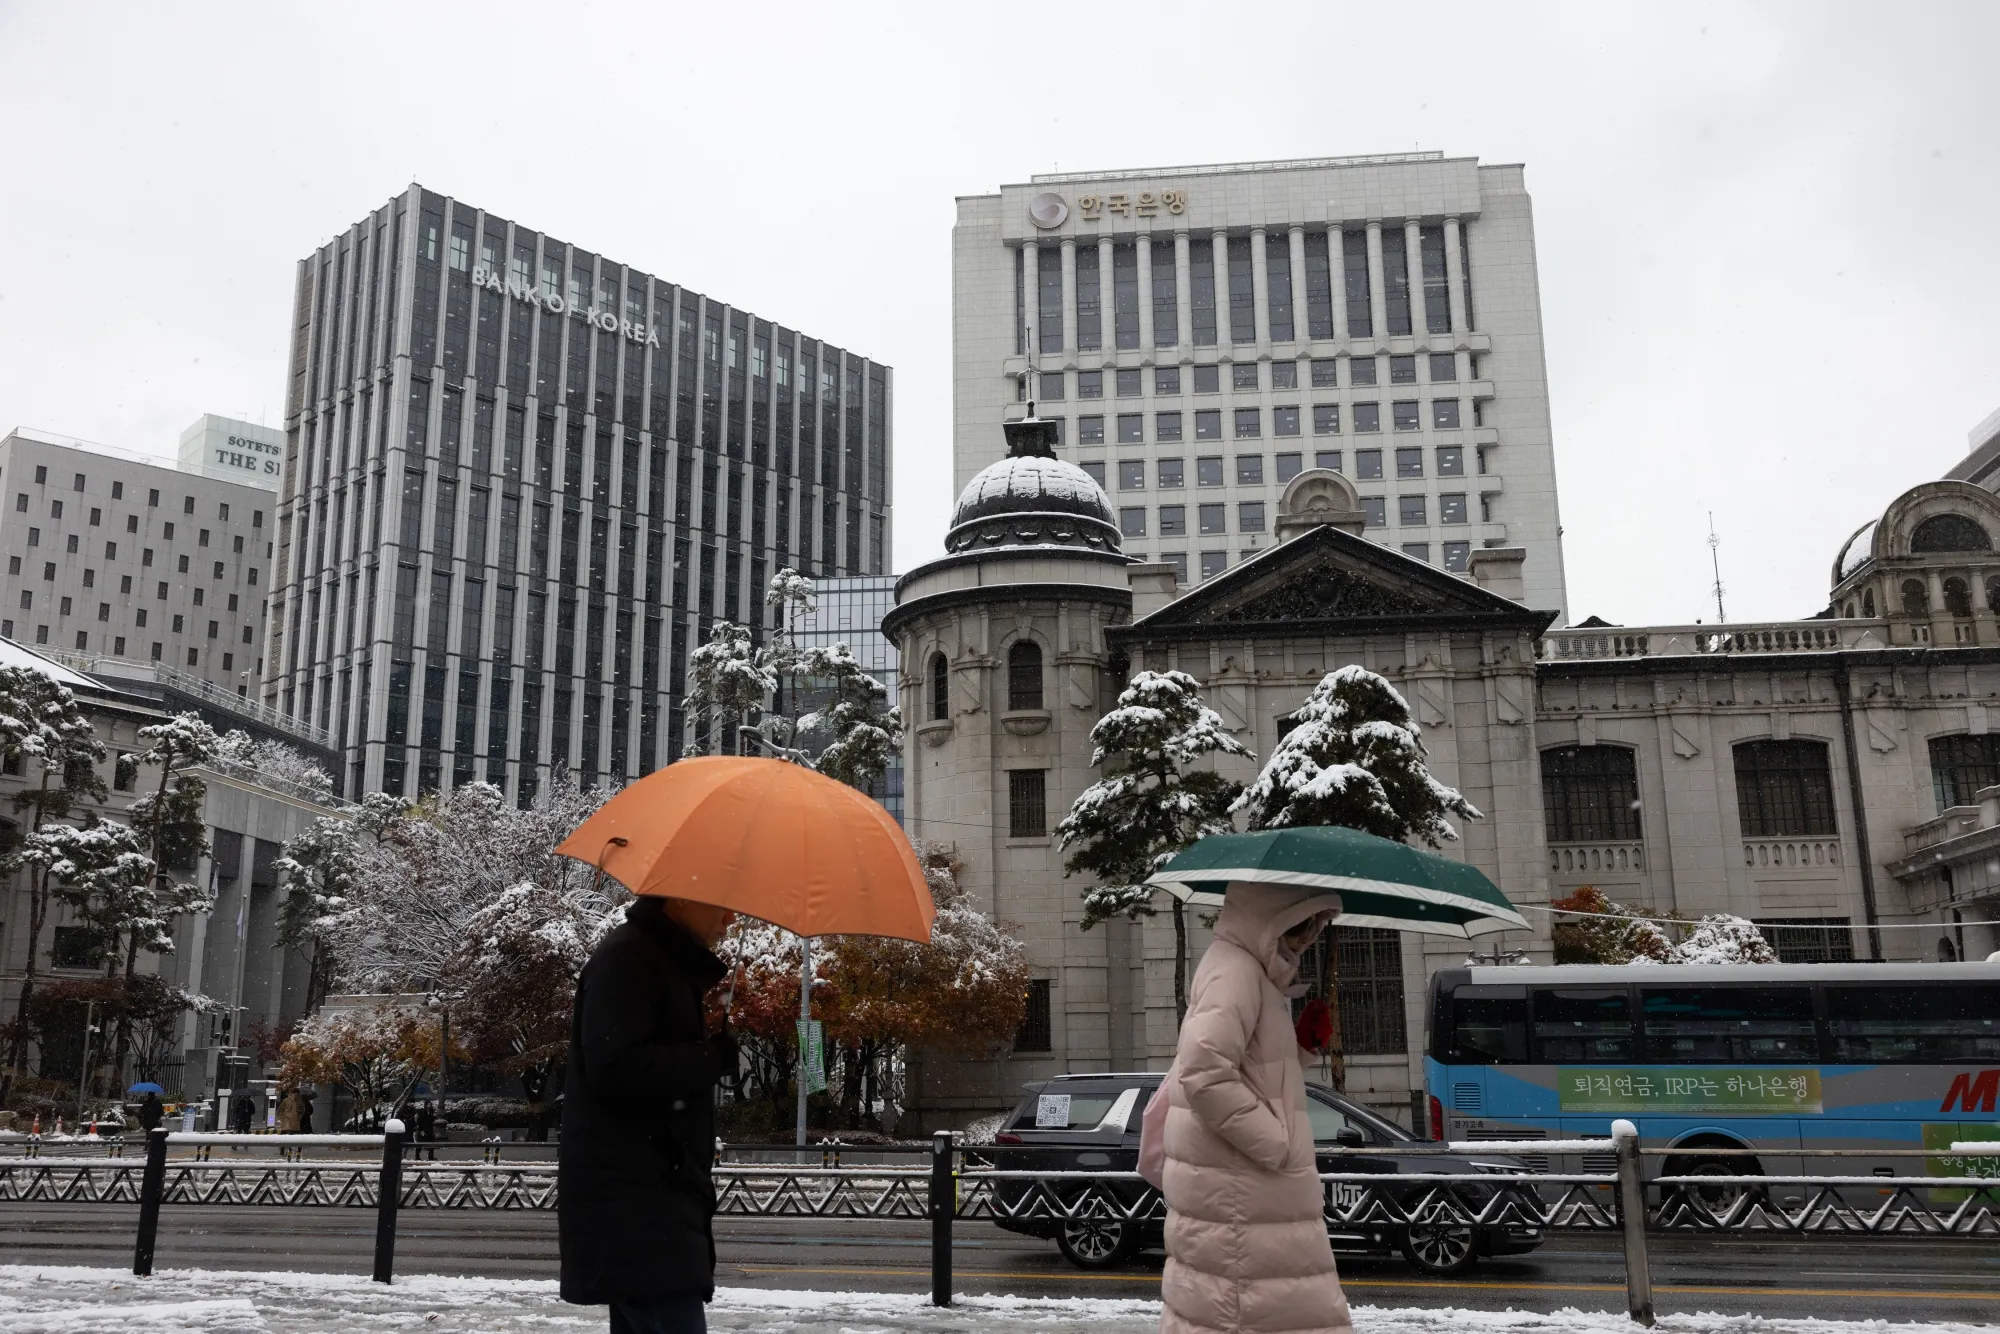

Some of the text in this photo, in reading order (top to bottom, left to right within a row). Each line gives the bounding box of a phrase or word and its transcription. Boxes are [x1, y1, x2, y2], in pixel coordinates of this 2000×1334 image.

[1079, 188, 1188, 221] 한국은행
[472, 265, 661, 349] BANK OF KOREA
[228, 435, 281, 456] SOTETS
[216, 449, 257, 471] THE
[1574, 1075, 1808, 1098] 퇴직연금, IRP는 하나은행
[1454, 1120, 1484, 1129] 경기고속
